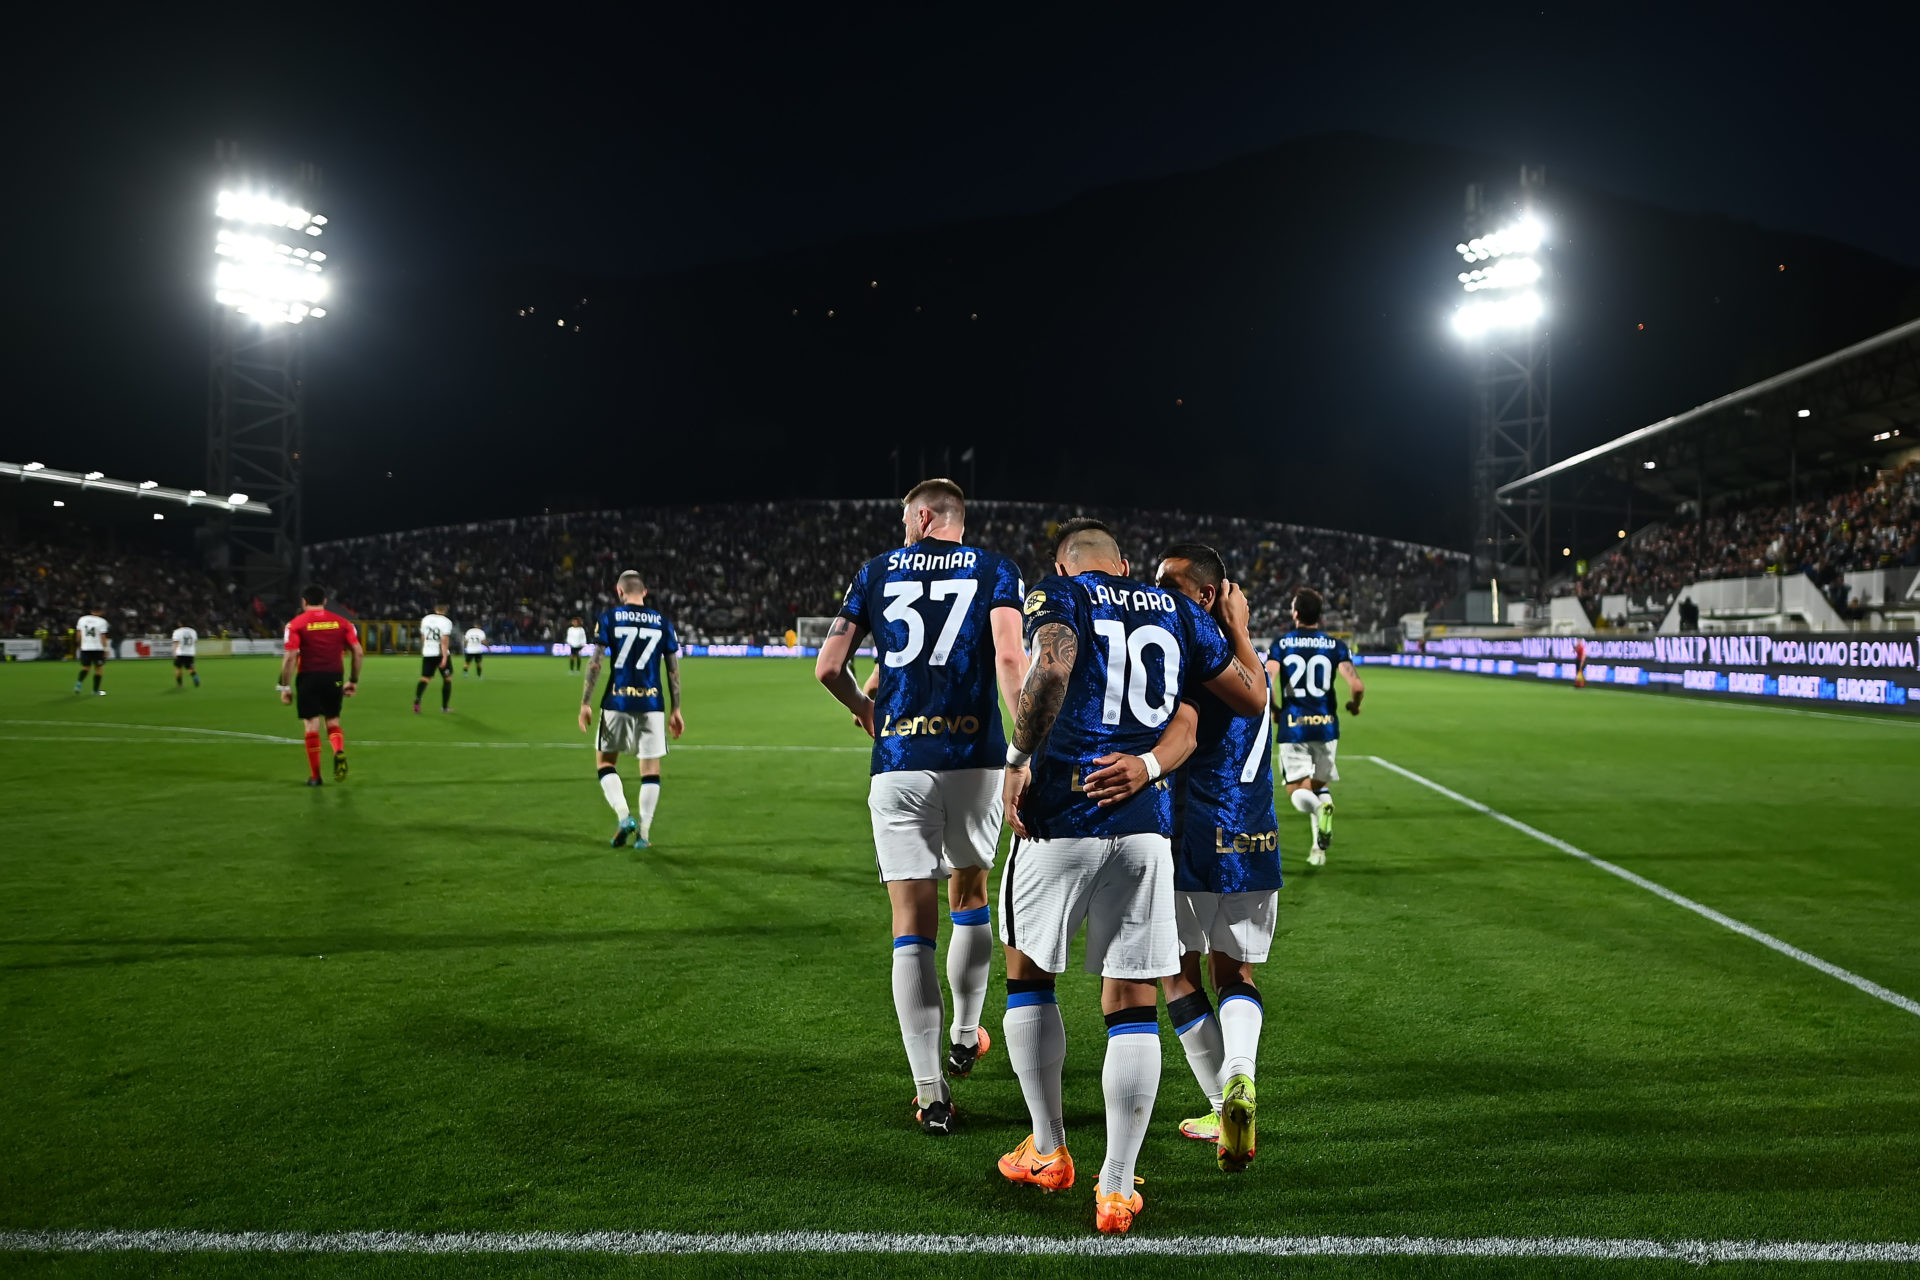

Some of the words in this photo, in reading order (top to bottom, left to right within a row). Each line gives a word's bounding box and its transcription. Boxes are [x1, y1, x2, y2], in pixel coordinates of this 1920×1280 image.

[1084, 583, 1177, 612] LAUTARO
[84, 625, 97, 637] 14
[425, 626, 441, 641] 28
[882, 578, 979, 668] 37
[614, 626, 663, 670] 77
[1708, 636, 1772, 666] MARKUP
[1772, 641, 1807, 664] MODA
[1808, 641, 1848, 666] UOMO
[1849, 641, 1859, 666] E
[1860, 642, 1915, 667] DONNA
[1094, 619, 1181, 728] 10
[1283, 654, 1332, 698] 20
[880, 714, 979, 737] Lenovo
[1215, 827, 1278, 854] Leno
